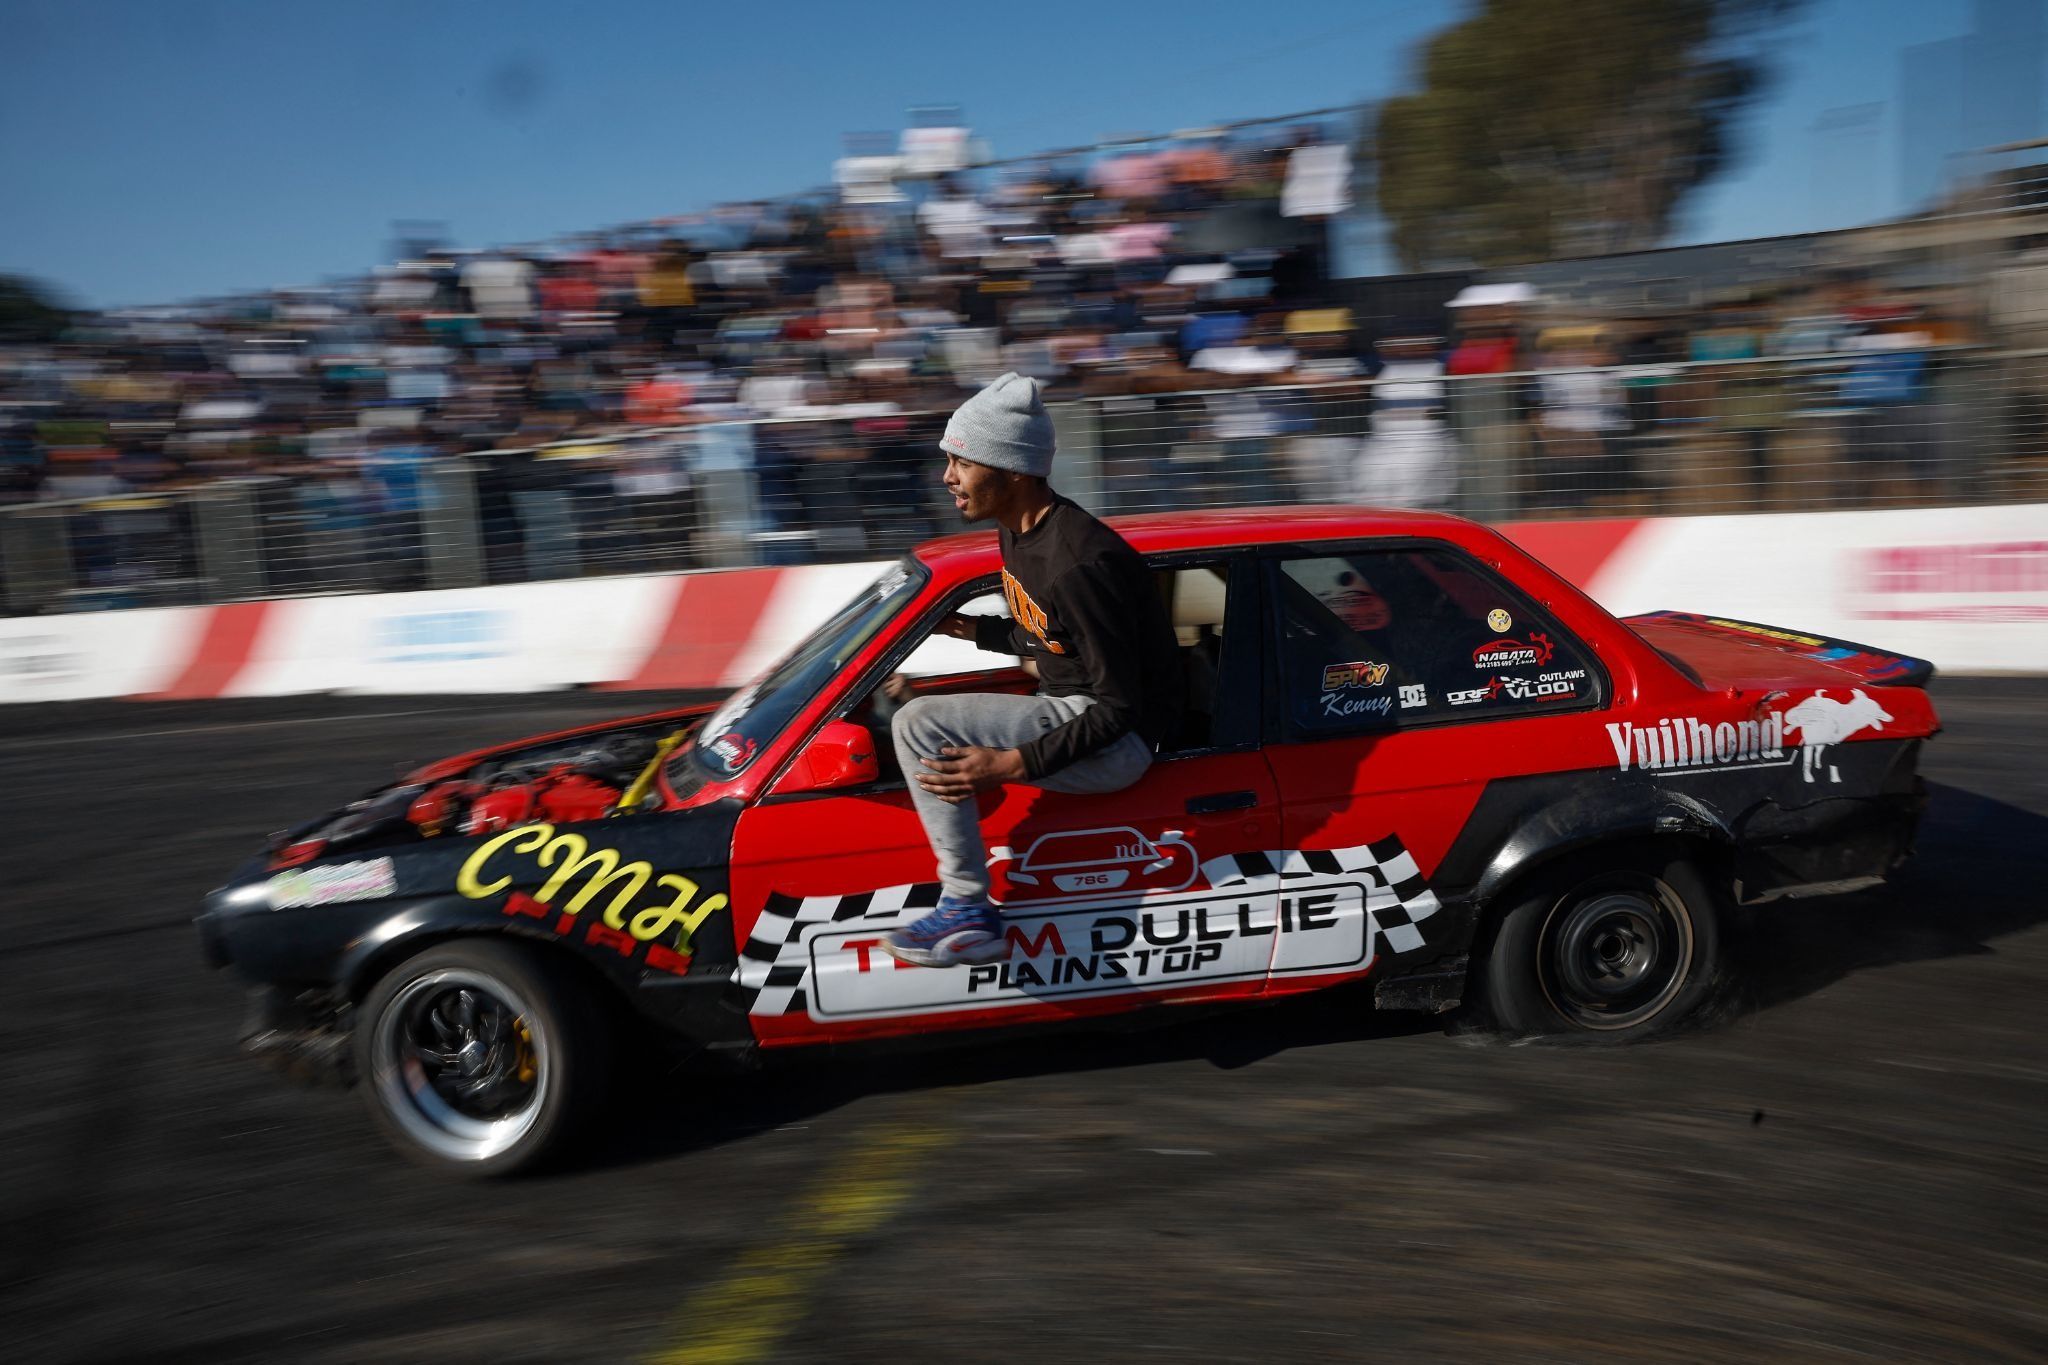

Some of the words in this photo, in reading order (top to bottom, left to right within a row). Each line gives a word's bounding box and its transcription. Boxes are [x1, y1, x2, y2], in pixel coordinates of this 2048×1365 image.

[1478, 649, 1535, 662] NAGATA
[1539, 669, 1586, 682] OUTLAWS
[1320, 692, 1393, 716] Kenny
[1605, 711, 1785, 772] Vuilhond
[1073, 873, 1110, 886] 786
[841, 922, 1067, 974] TM
[1090, 893, 1342, 950] DULLIE
[967, 942, 1222, 994] PLAINSTOP
